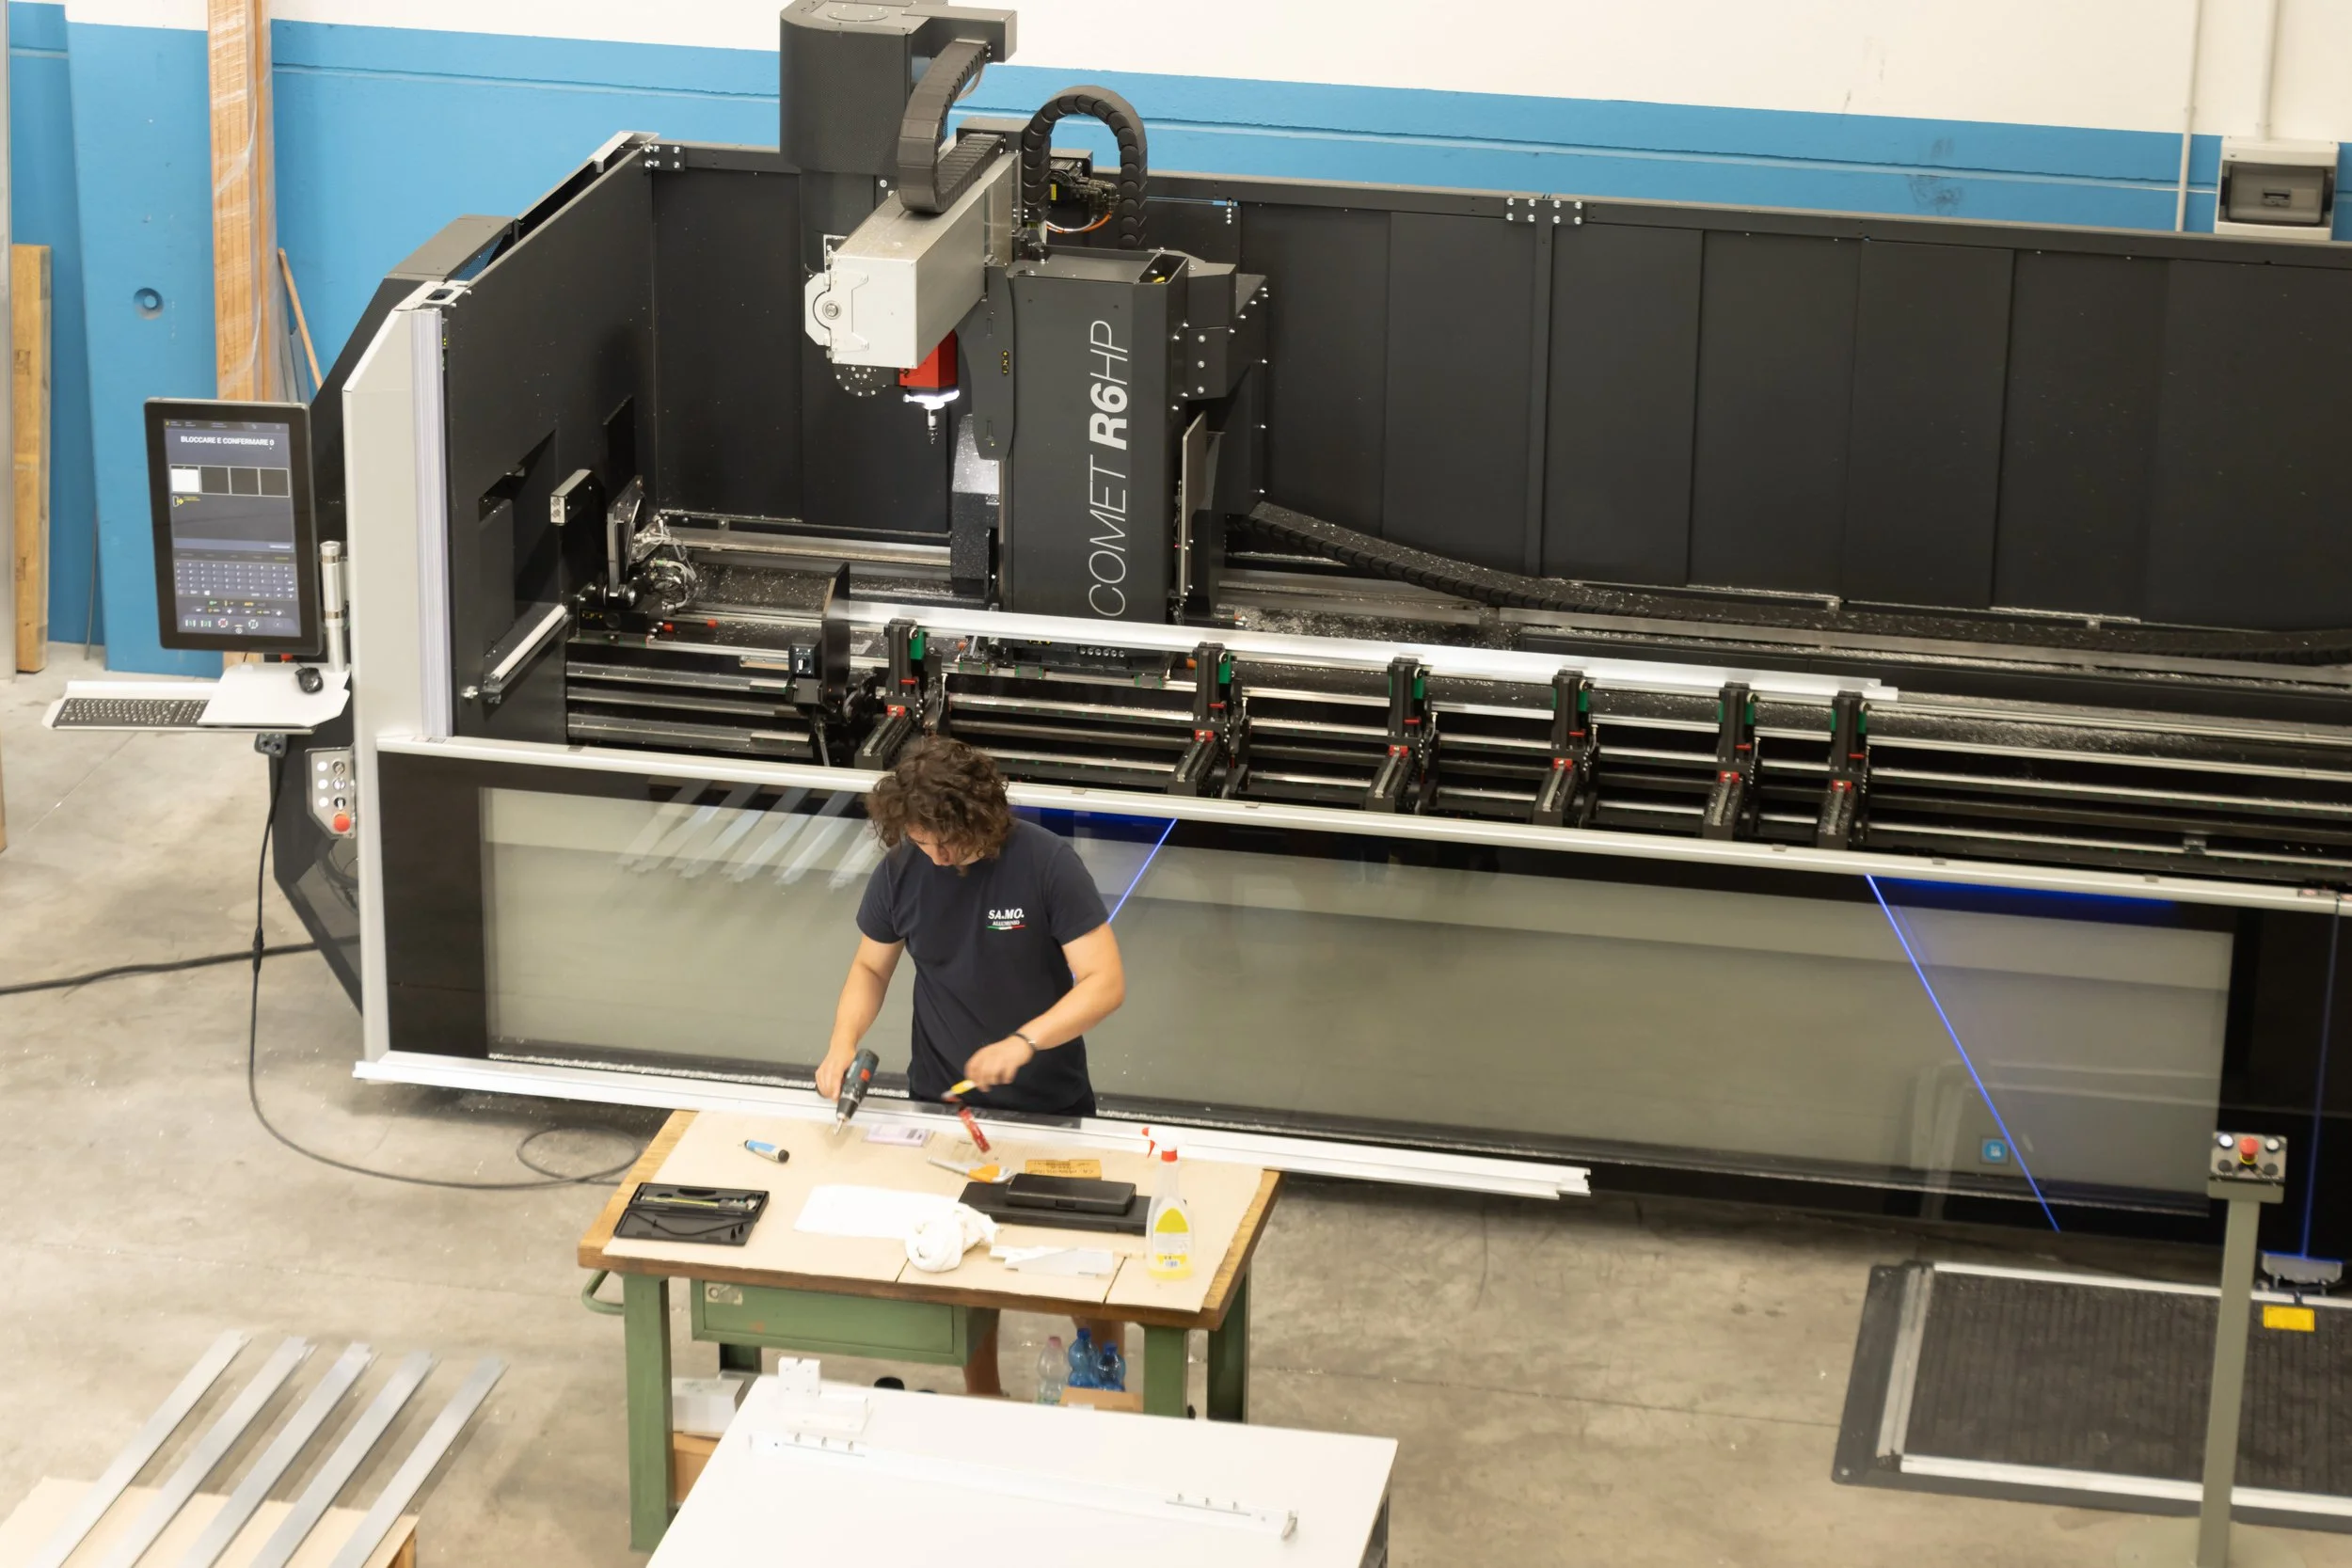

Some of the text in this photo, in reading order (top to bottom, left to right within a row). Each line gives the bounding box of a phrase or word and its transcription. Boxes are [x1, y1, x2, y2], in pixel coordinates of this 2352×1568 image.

[181, 436, 215, 444] BLOCCARE
[223, 437, 268, 446] CONFERMARE
[1089, 320, 1128, 616] COMET R6HP
